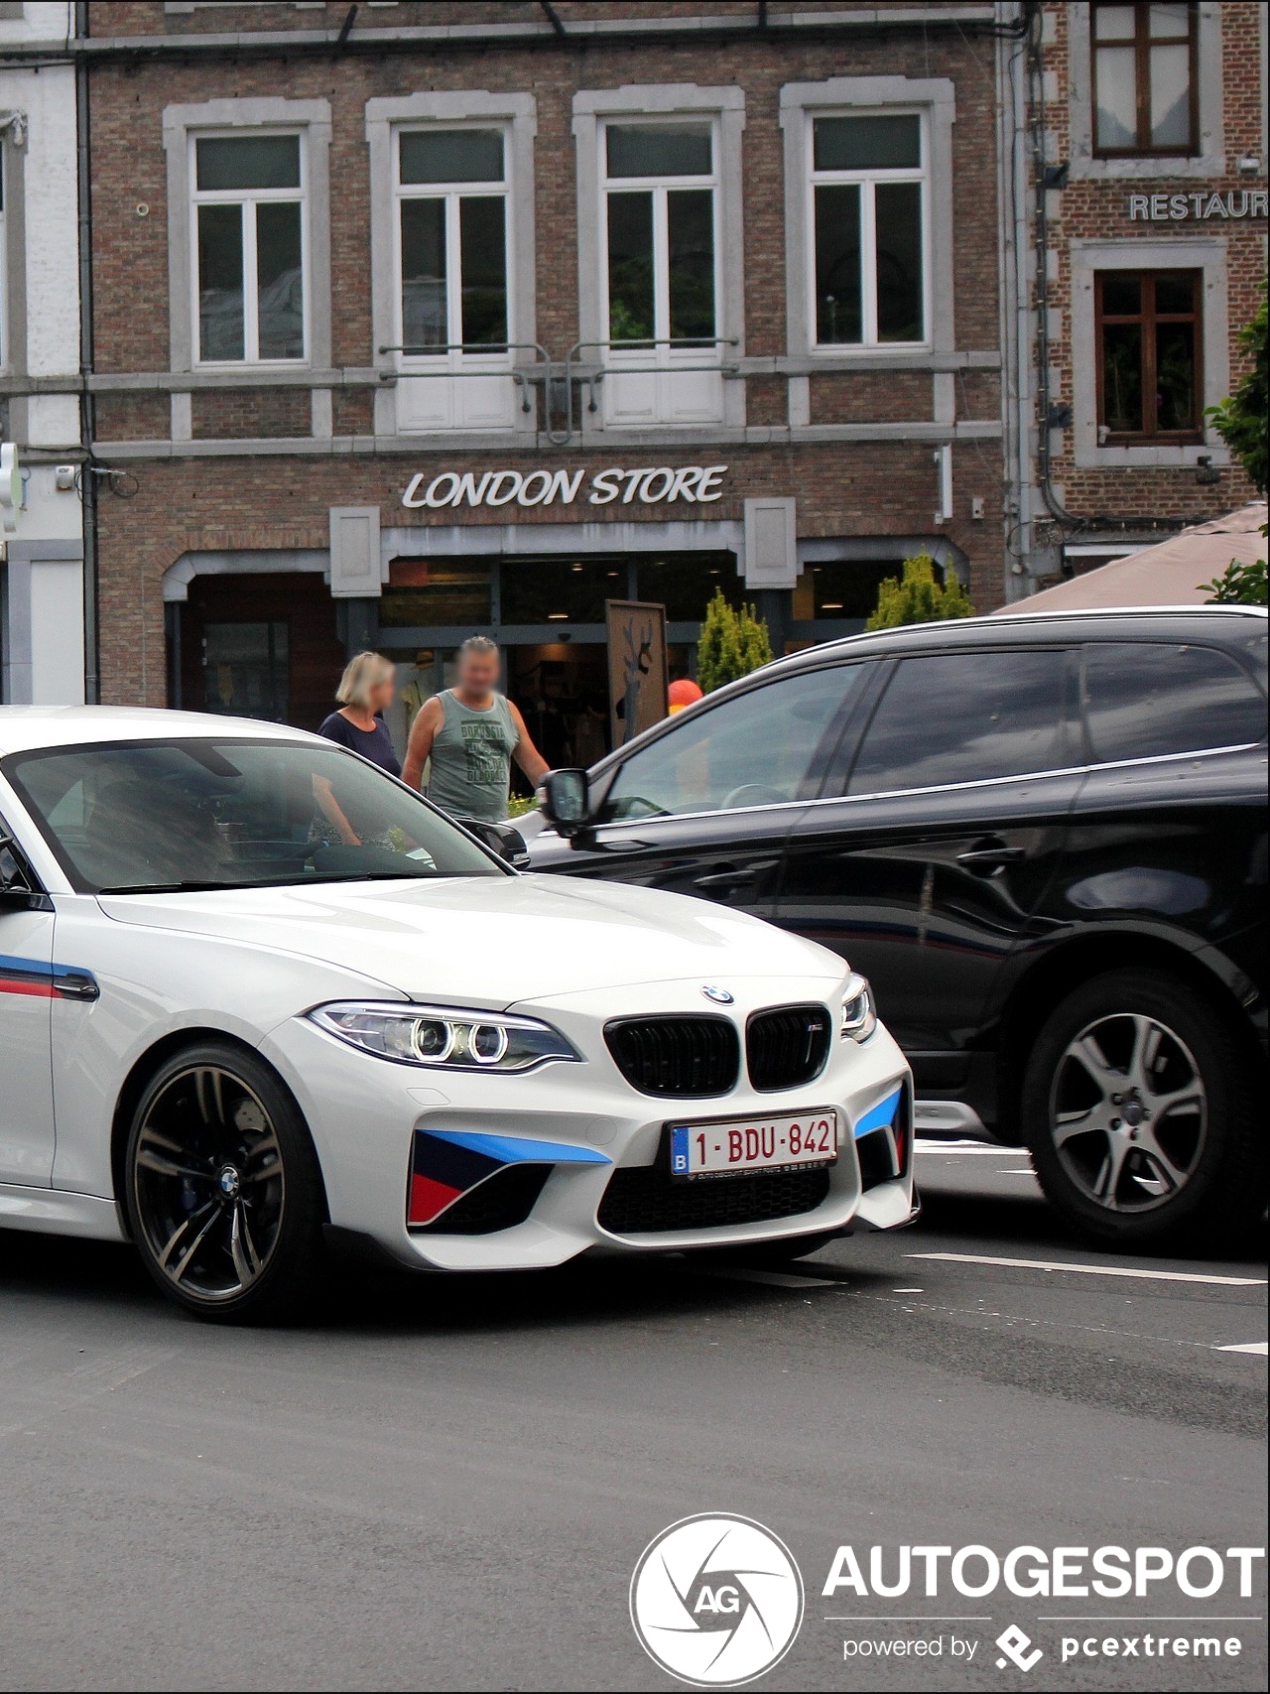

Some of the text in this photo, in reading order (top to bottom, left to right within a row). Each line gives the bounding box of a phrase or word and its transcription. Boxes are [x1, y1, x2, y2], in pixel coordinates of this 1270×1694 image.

[402, 466, 728, 508] LONDON STORE
[461, 725, 505, 738] BORUSSIA
[675, 1155, 687, 1170] B
